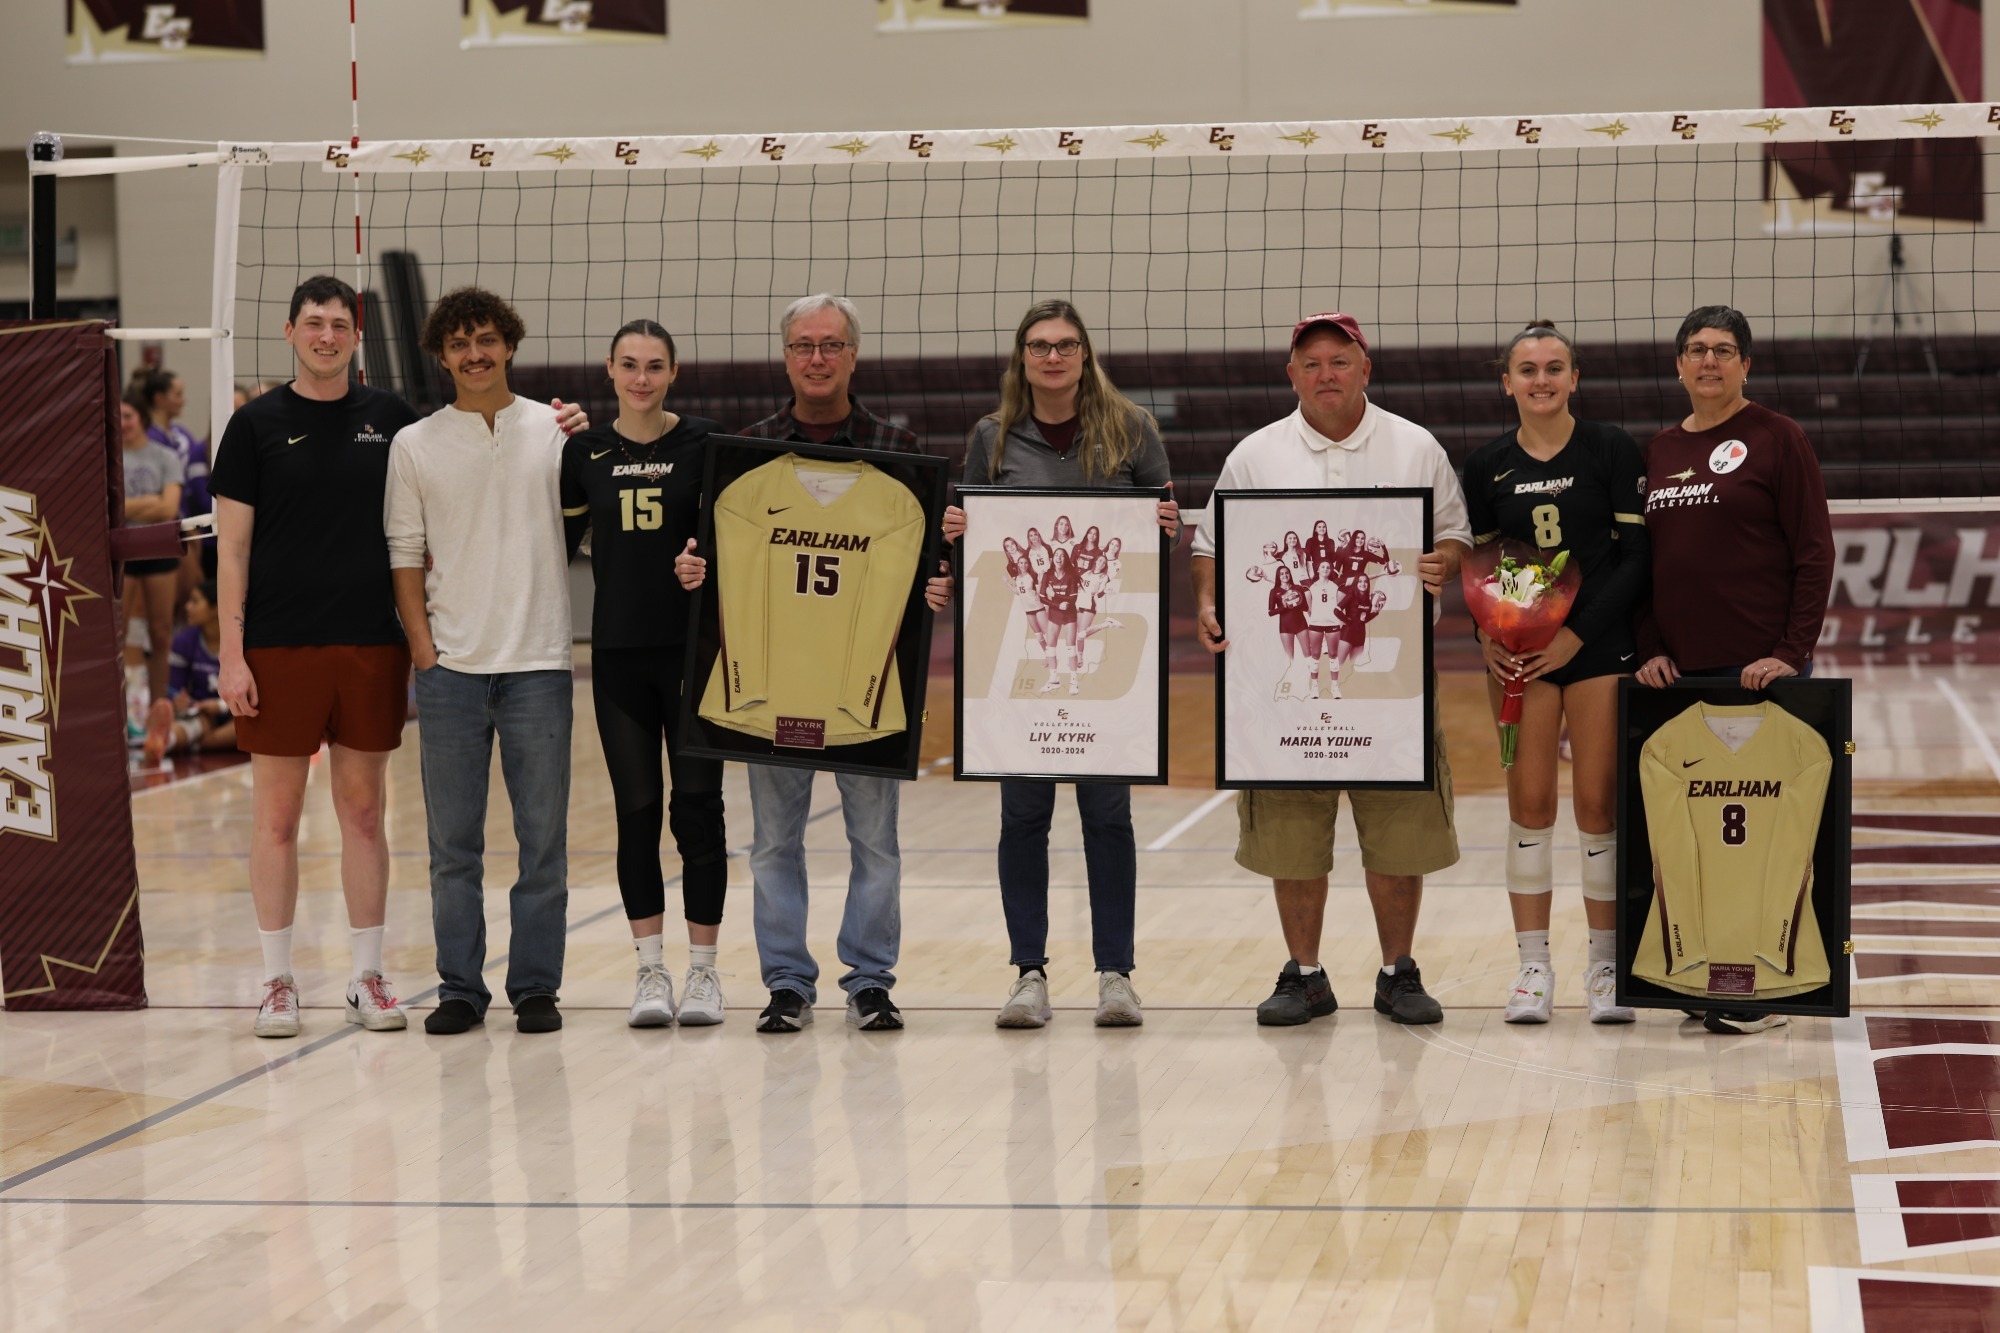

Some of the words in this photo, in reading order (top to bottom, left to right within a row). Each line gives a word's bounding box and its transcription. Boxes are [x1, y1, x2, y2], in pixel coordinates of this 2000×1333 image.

[1987, 105, 2000, 131] E
[611, 463, 674, 477] EARLHAM
[1712, 459, 1729, 472] #8
[1514, 476, 1575, 495] EARLHAM
[1647, 483, 1714, 504] EARLHAM
[619, 488, 663, 531] 15
[1644, 495, 1720, 515] OLLEYBALL
[1532, 504, 1563, 548] 8
[769, 527, 871, 553] EARLHAM
[795, 552, 840, 597] 15
[732, 660, 741, 694] EARLHAM
[778, 719, 795, 727] LIV
[796, 721, 823, 730] KYRK
[1029, 732, 1052, 742] LIV
[1057, 732, 1096, 743] KYRK
[1279, 736, 1322, 747] MARIA
[1327, 736, 1372, 747] YOUNG
[1041, 746, 1085, 755] 2020-2024
[1303, 751, 1349, 759] 2020-2024
[1687, 780, 1782, 798] EARLHAM
[1721, 802, 1748, 847] 8
[1672, 924, 1684, 958] EARLHAM
